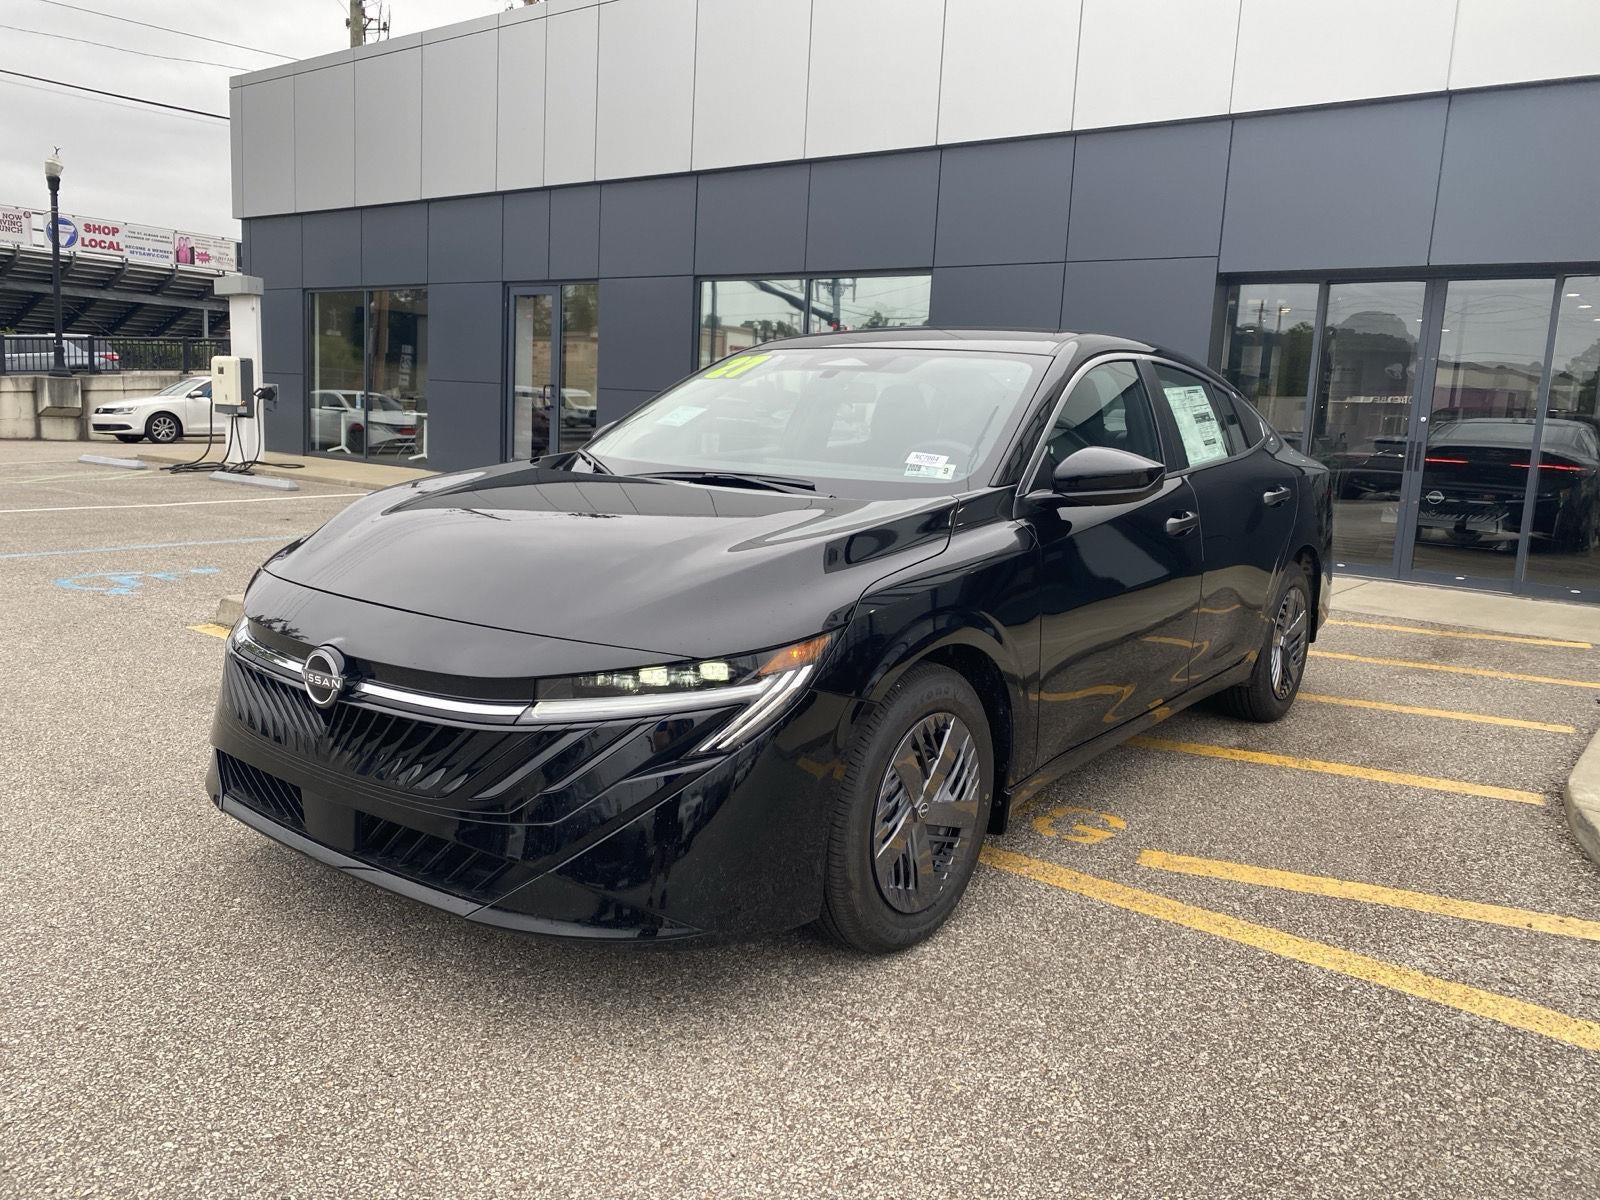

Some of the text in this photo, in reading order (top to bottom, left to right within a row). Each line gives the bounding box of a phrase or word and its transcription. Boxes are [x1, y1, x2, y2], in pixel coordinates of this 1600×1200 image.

[2, 212, 23, 221] NOW
[83, 222, 120, 237] SHOP
[80, 236, 124, 252] LOCAL
[124, 244, 146, 252] BECOME
[942, 467, 950, 475] 9
